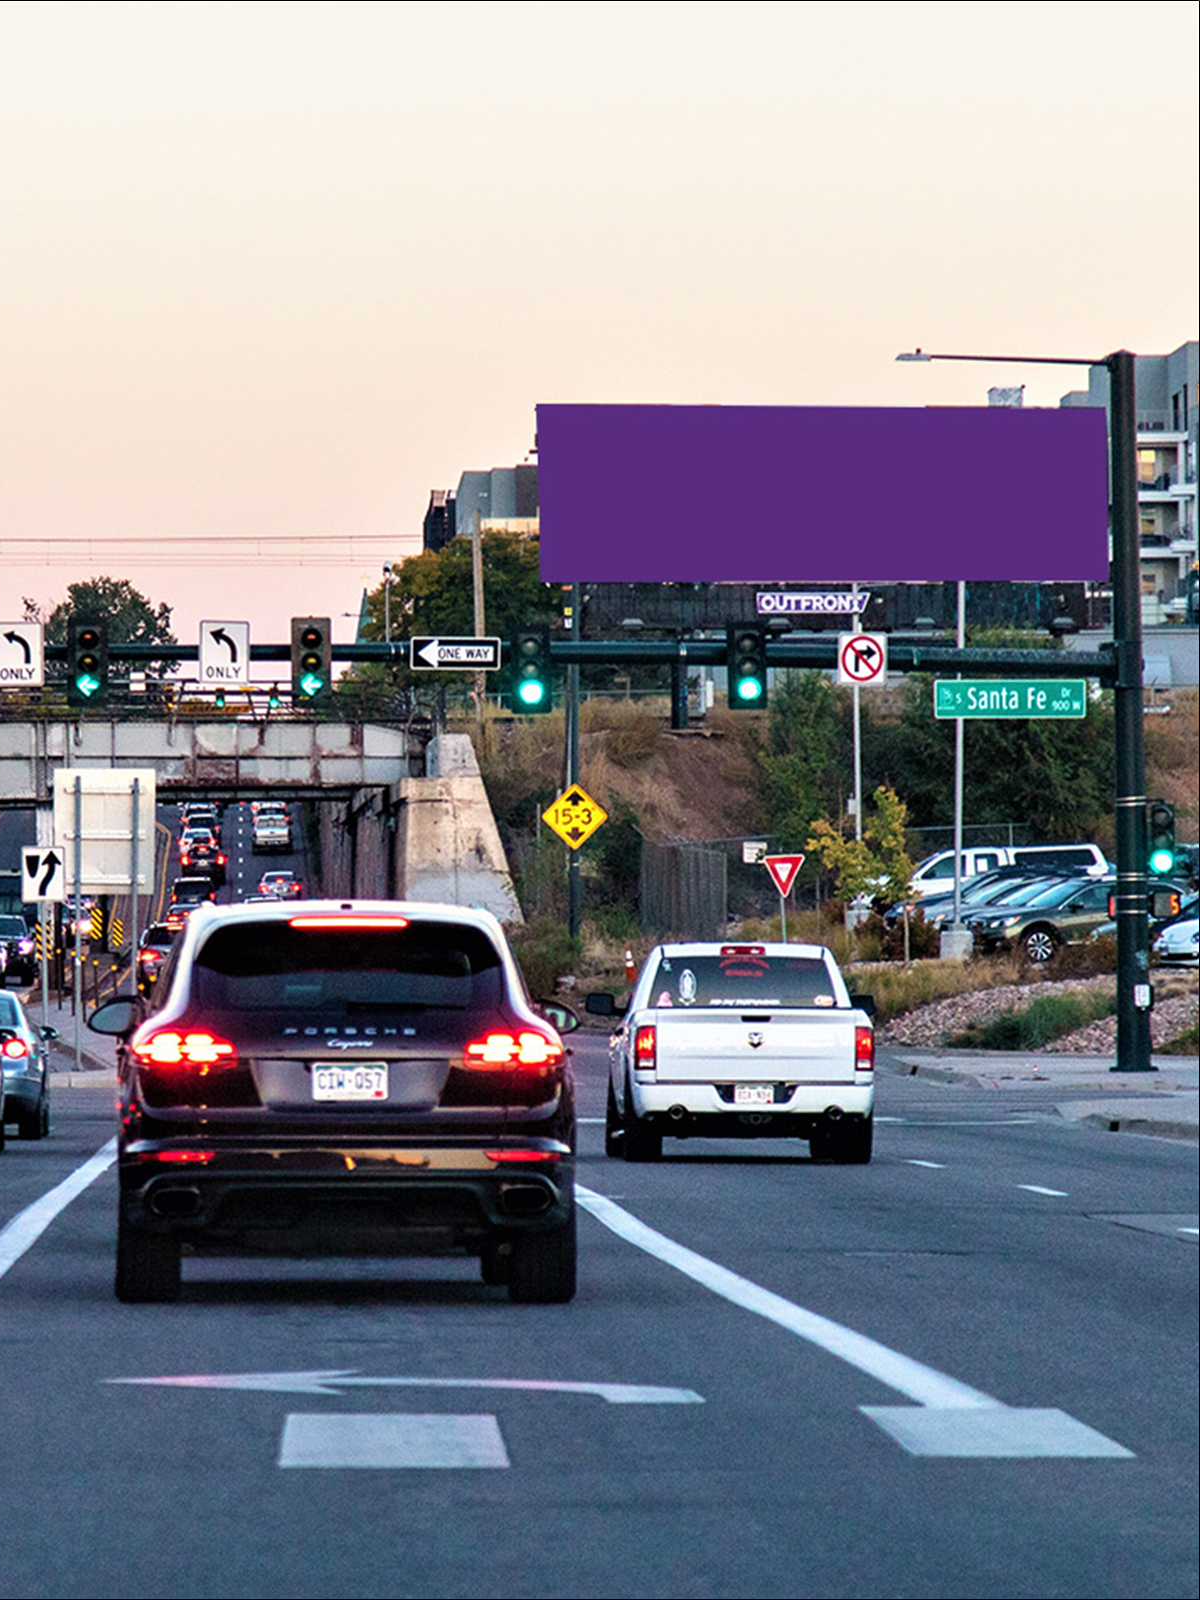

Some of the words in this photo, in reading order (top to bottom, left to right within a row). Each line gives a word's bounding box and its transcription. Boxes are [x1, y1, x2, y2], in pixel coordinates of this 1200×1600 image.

[761, 595, 864, 611] OUTFRONT
[438, 647, 462, 660] ONE
[465, 647, 490, 659] WAY
[0, 667, 36, 681] ONLY
[206, 665, 242, 679] ONLY
[967, 686, 1019, 710] Santa
[1027, 686, 1047, 710] Fe
[1061, 686, 1072, 698] Dr
[1051, 700, 1071, 711] 900
[1072, 701, 1082, 711] W
[1169, 893, 1180, 915] 5
[283, 1026, 417, 1036] PORSCHE
